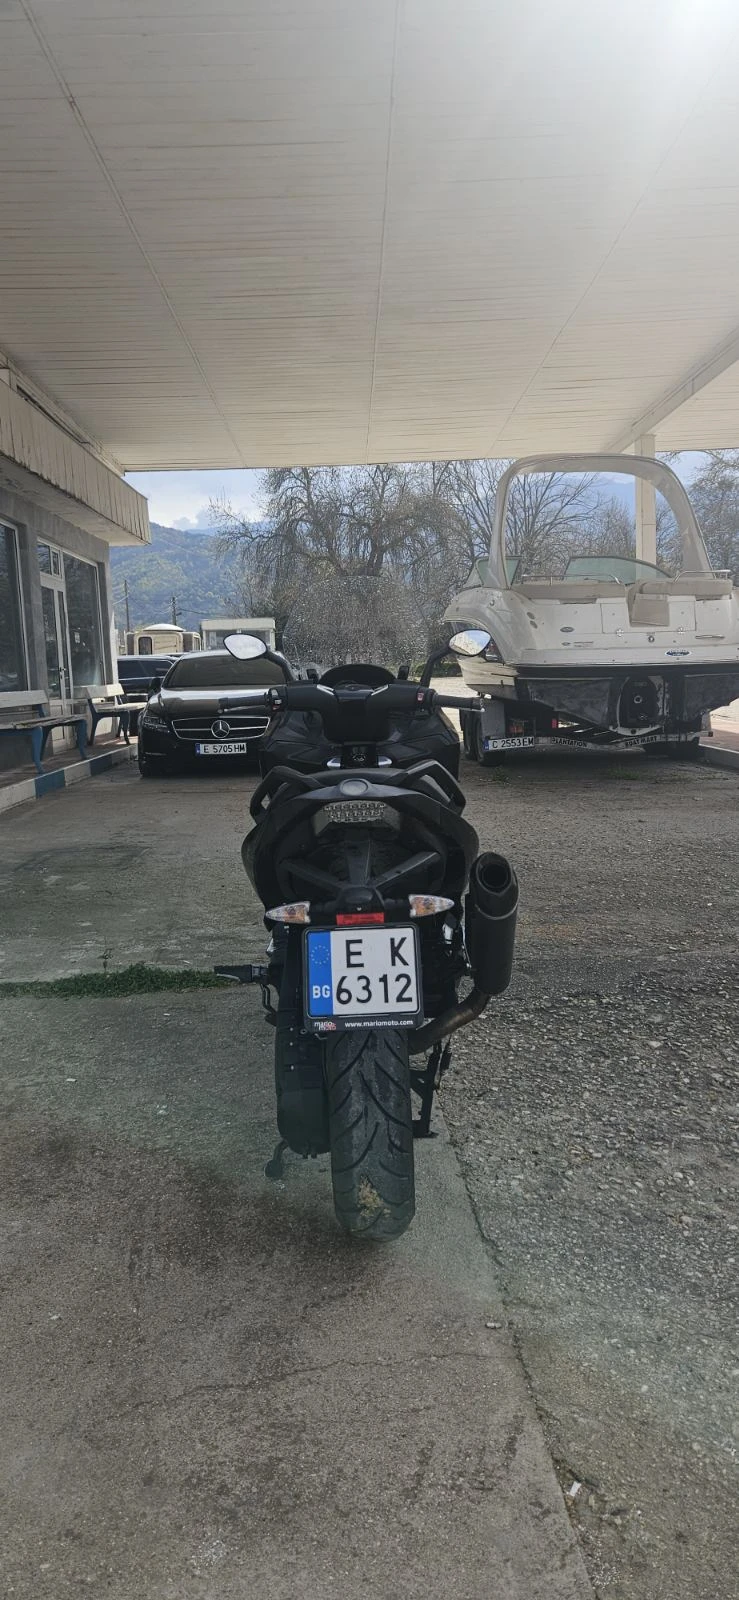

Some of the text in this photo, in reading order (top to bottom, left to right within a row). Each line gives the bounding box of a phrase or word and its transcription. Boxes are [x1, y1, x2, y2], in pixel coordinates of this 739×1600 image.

[203, 744, 210, 753] E
[213, 744, 233, 753] 5705
[234, 743, 246, 752] HM
[492, 740, 499, 749] C
[501, 738, 522, 748] 2553
[345, 937, 409, 968] E K
[312, 985, 331, 999] BG
[336, 973, 413, 1005] 6312
[344, 1019, 414, 1028] www.mariomoto.com
